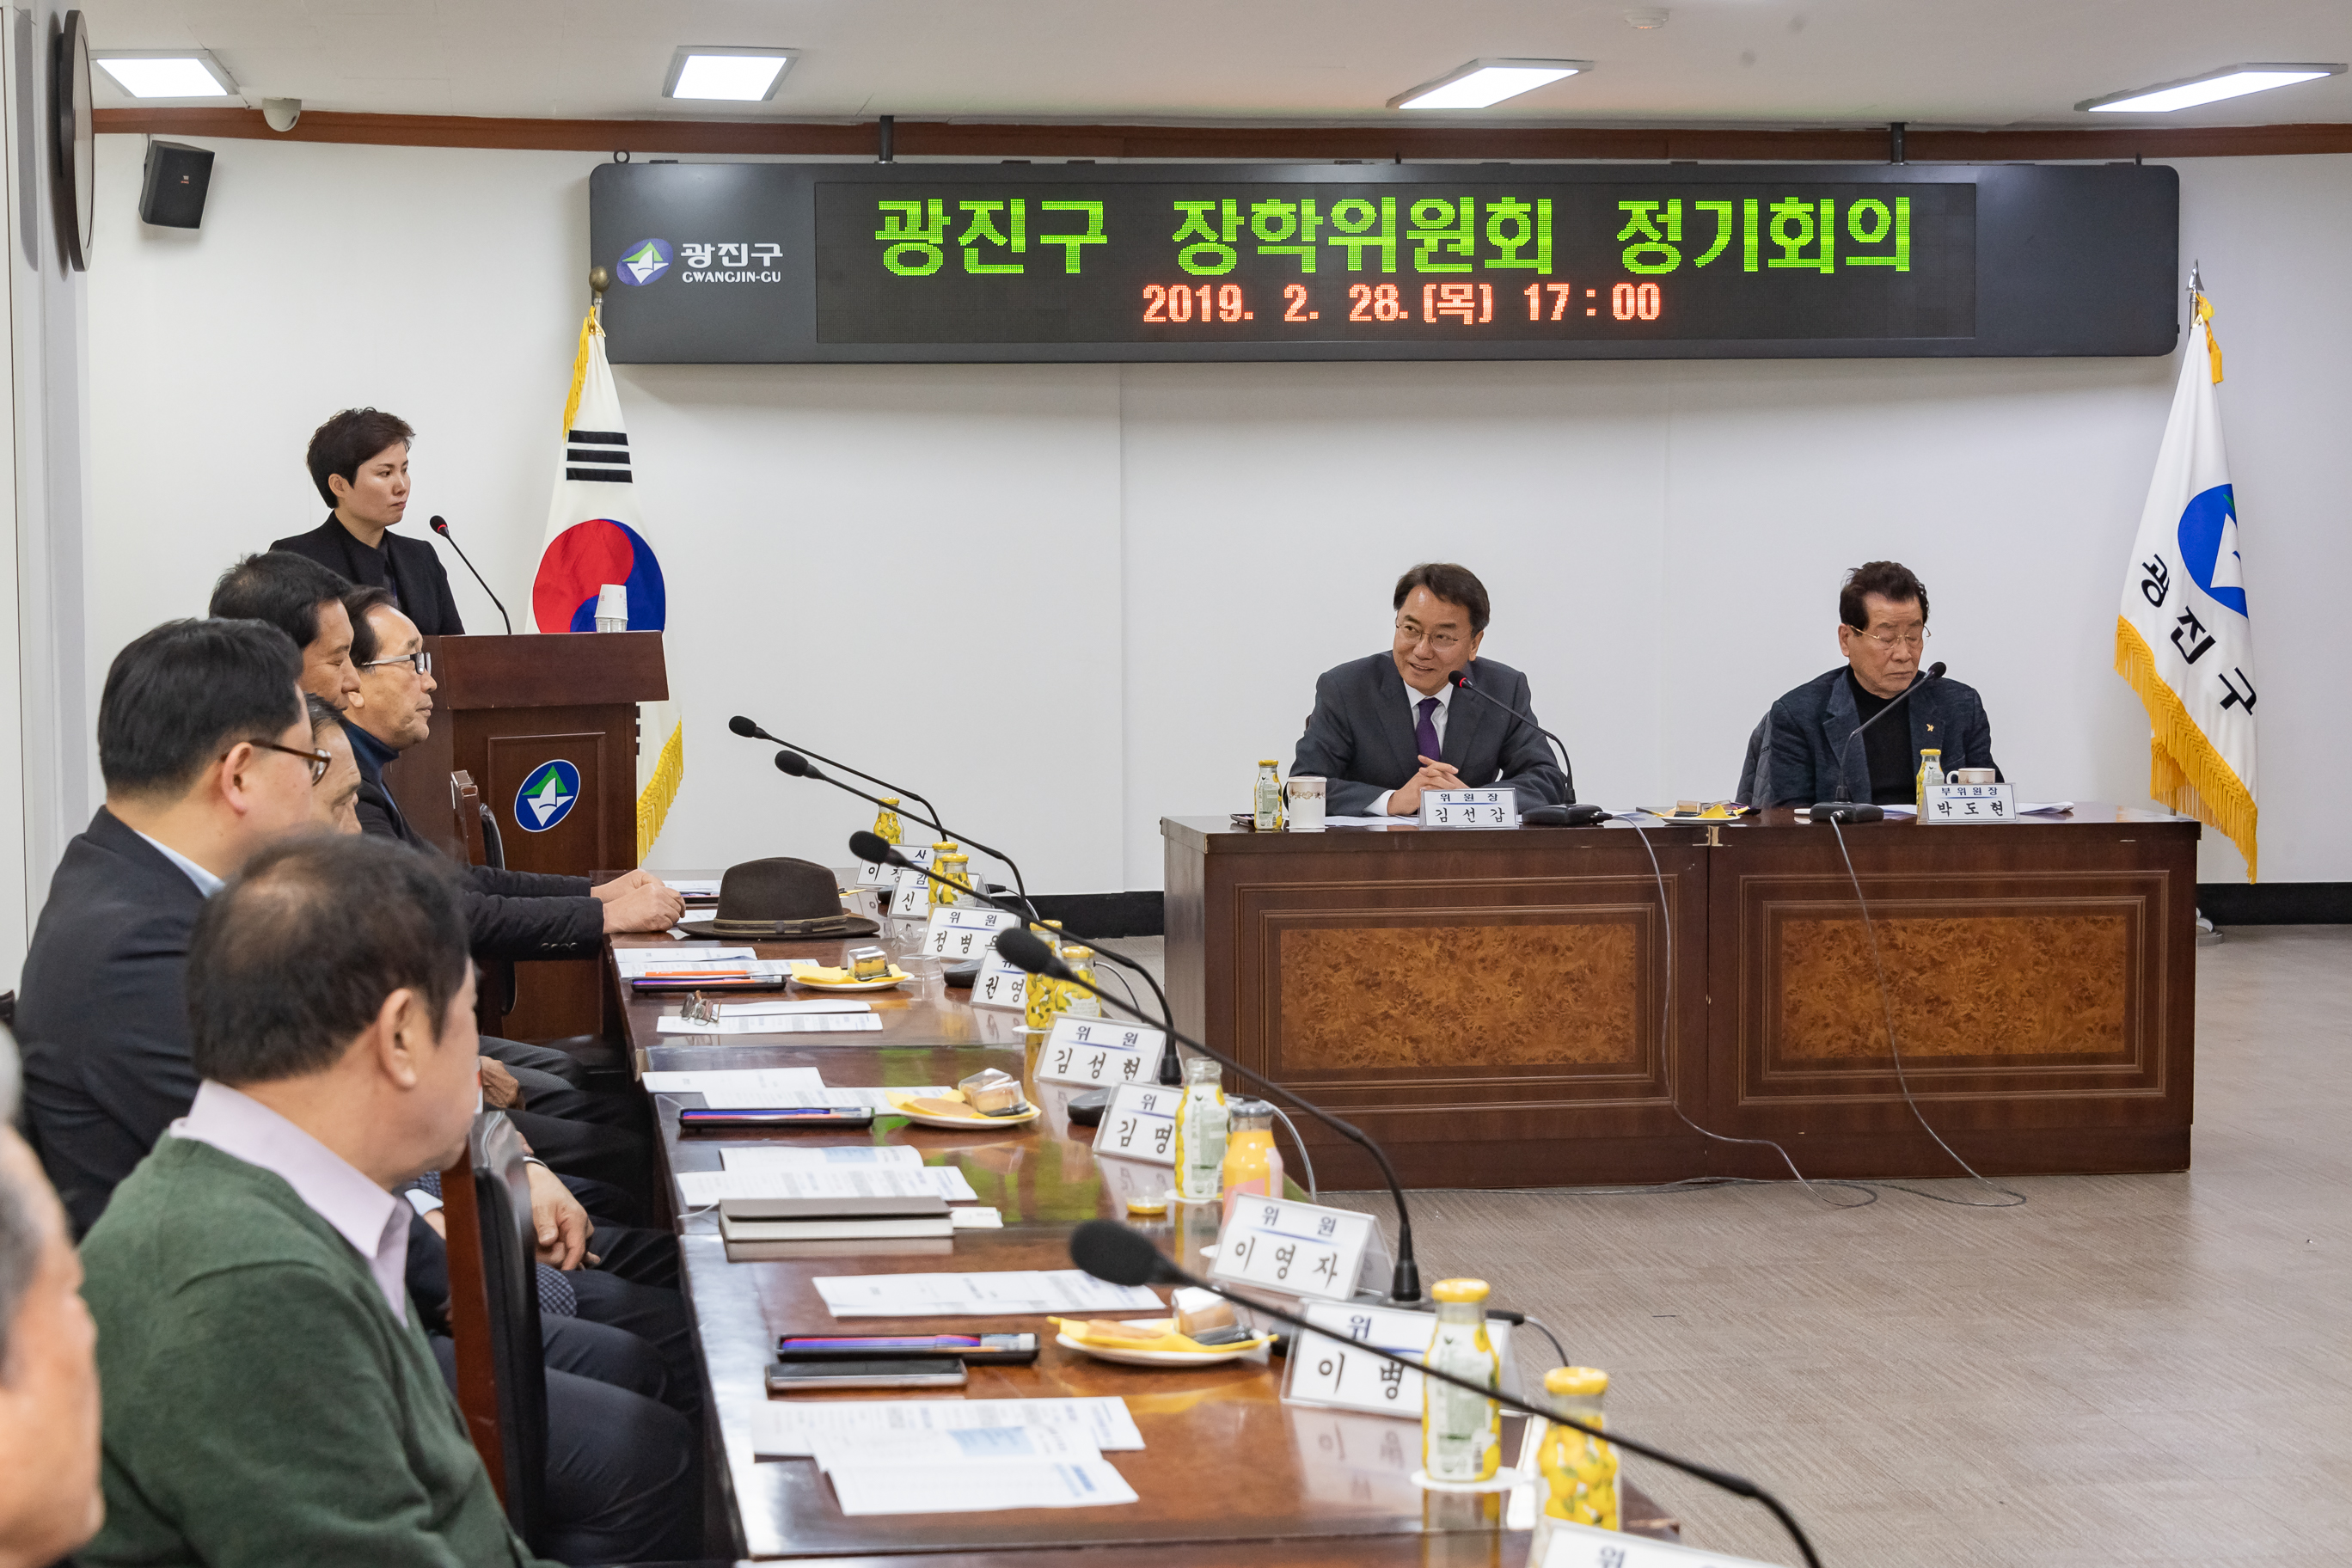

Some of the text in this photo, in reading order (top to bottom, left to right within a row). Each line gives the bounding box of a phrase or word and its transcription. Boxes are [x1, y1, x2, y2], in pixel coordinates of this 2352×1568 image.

[875, 196, 1911, 276] 광진구 장학위원회 정기회의
[680, 242, 783, 268] 광진구
[682, 271, 781, 283] GWANGJIN-GU
[1142, 284, 1253, 322] 2019.
[1283, 284, 1319, 322] 2.
